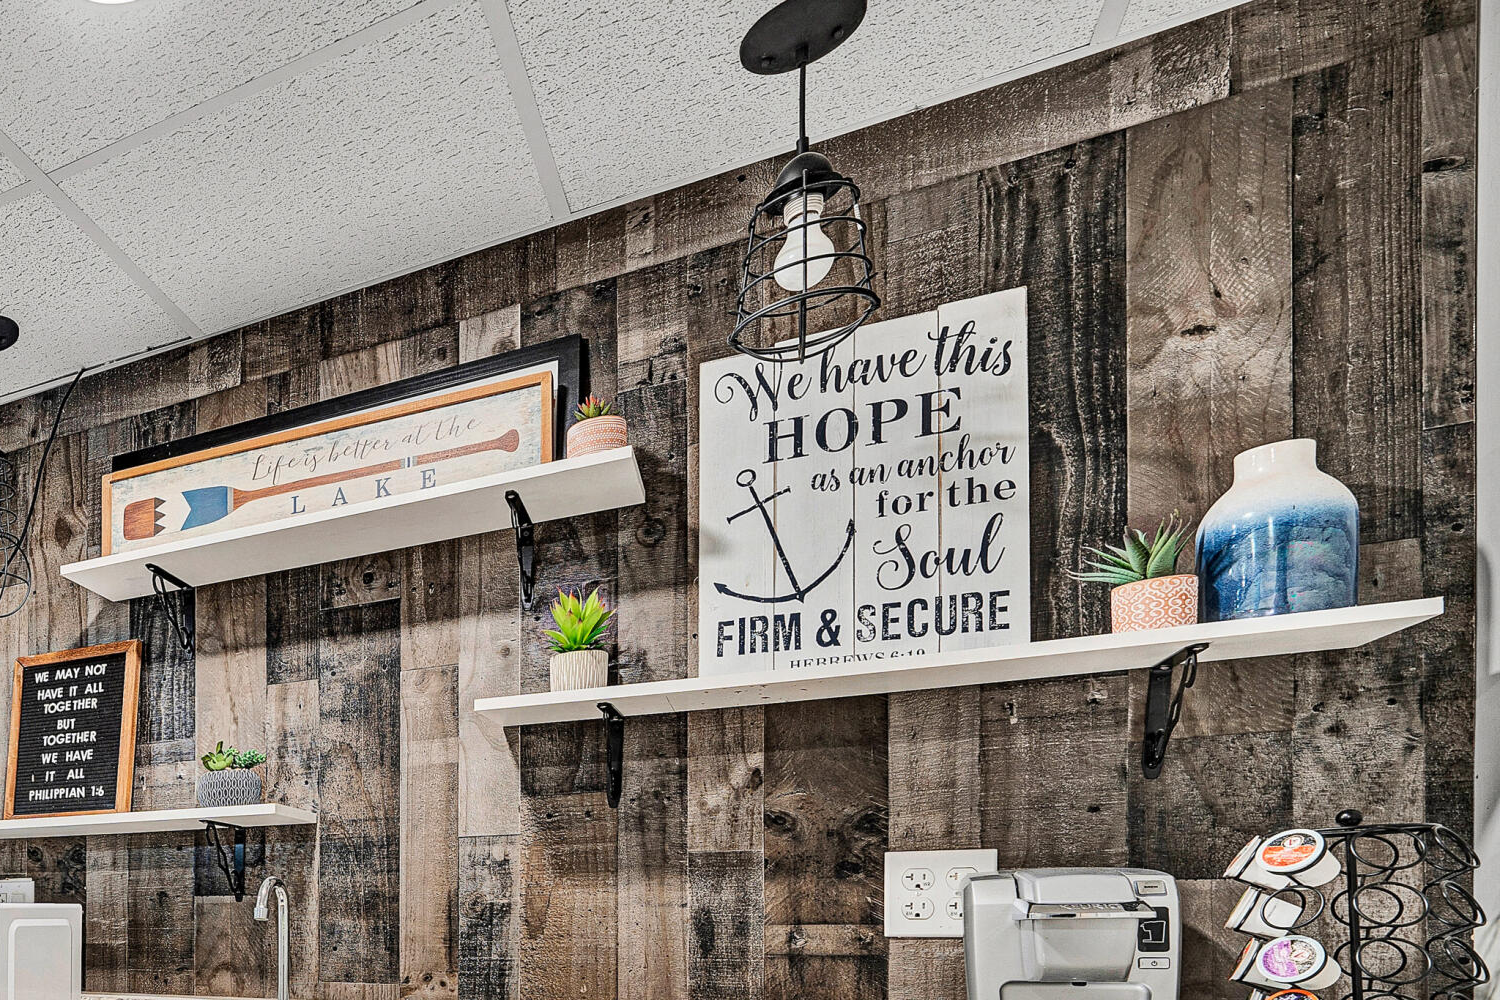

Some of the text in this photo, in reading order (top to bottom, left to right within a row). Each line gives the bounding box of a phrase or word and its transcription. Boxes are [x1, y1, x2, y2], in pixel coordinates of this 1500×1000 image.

[715, 320, 1012, 421] We have this
[762, 386, 962, 464] HOPE
[252, 414, 482, 486] Life is better at the
[811, 433, 1016, 491] as an anchor
[290, 468, 436, 515] LAKE
[875, 476, 1017, 519] for the
[872, 511, 1006, 591] Soul
[716, 589, 1011, 658] FIRM & SECURE
[35, 663, 107, 684] WE MAY NOT
[37, 682, 104, 701] HAVE IT ALL
[44, 698, 98, 714] TOGETHER
[43, 731, 97, 747] TOGETHER
[57, 718, 76, 730] BUT
[41, 749, 93, 765] WE HAVE
[45, 768, 85, 782] IT ALL
[29, 785, 104, 802] PHILIPPIAN 1:6
